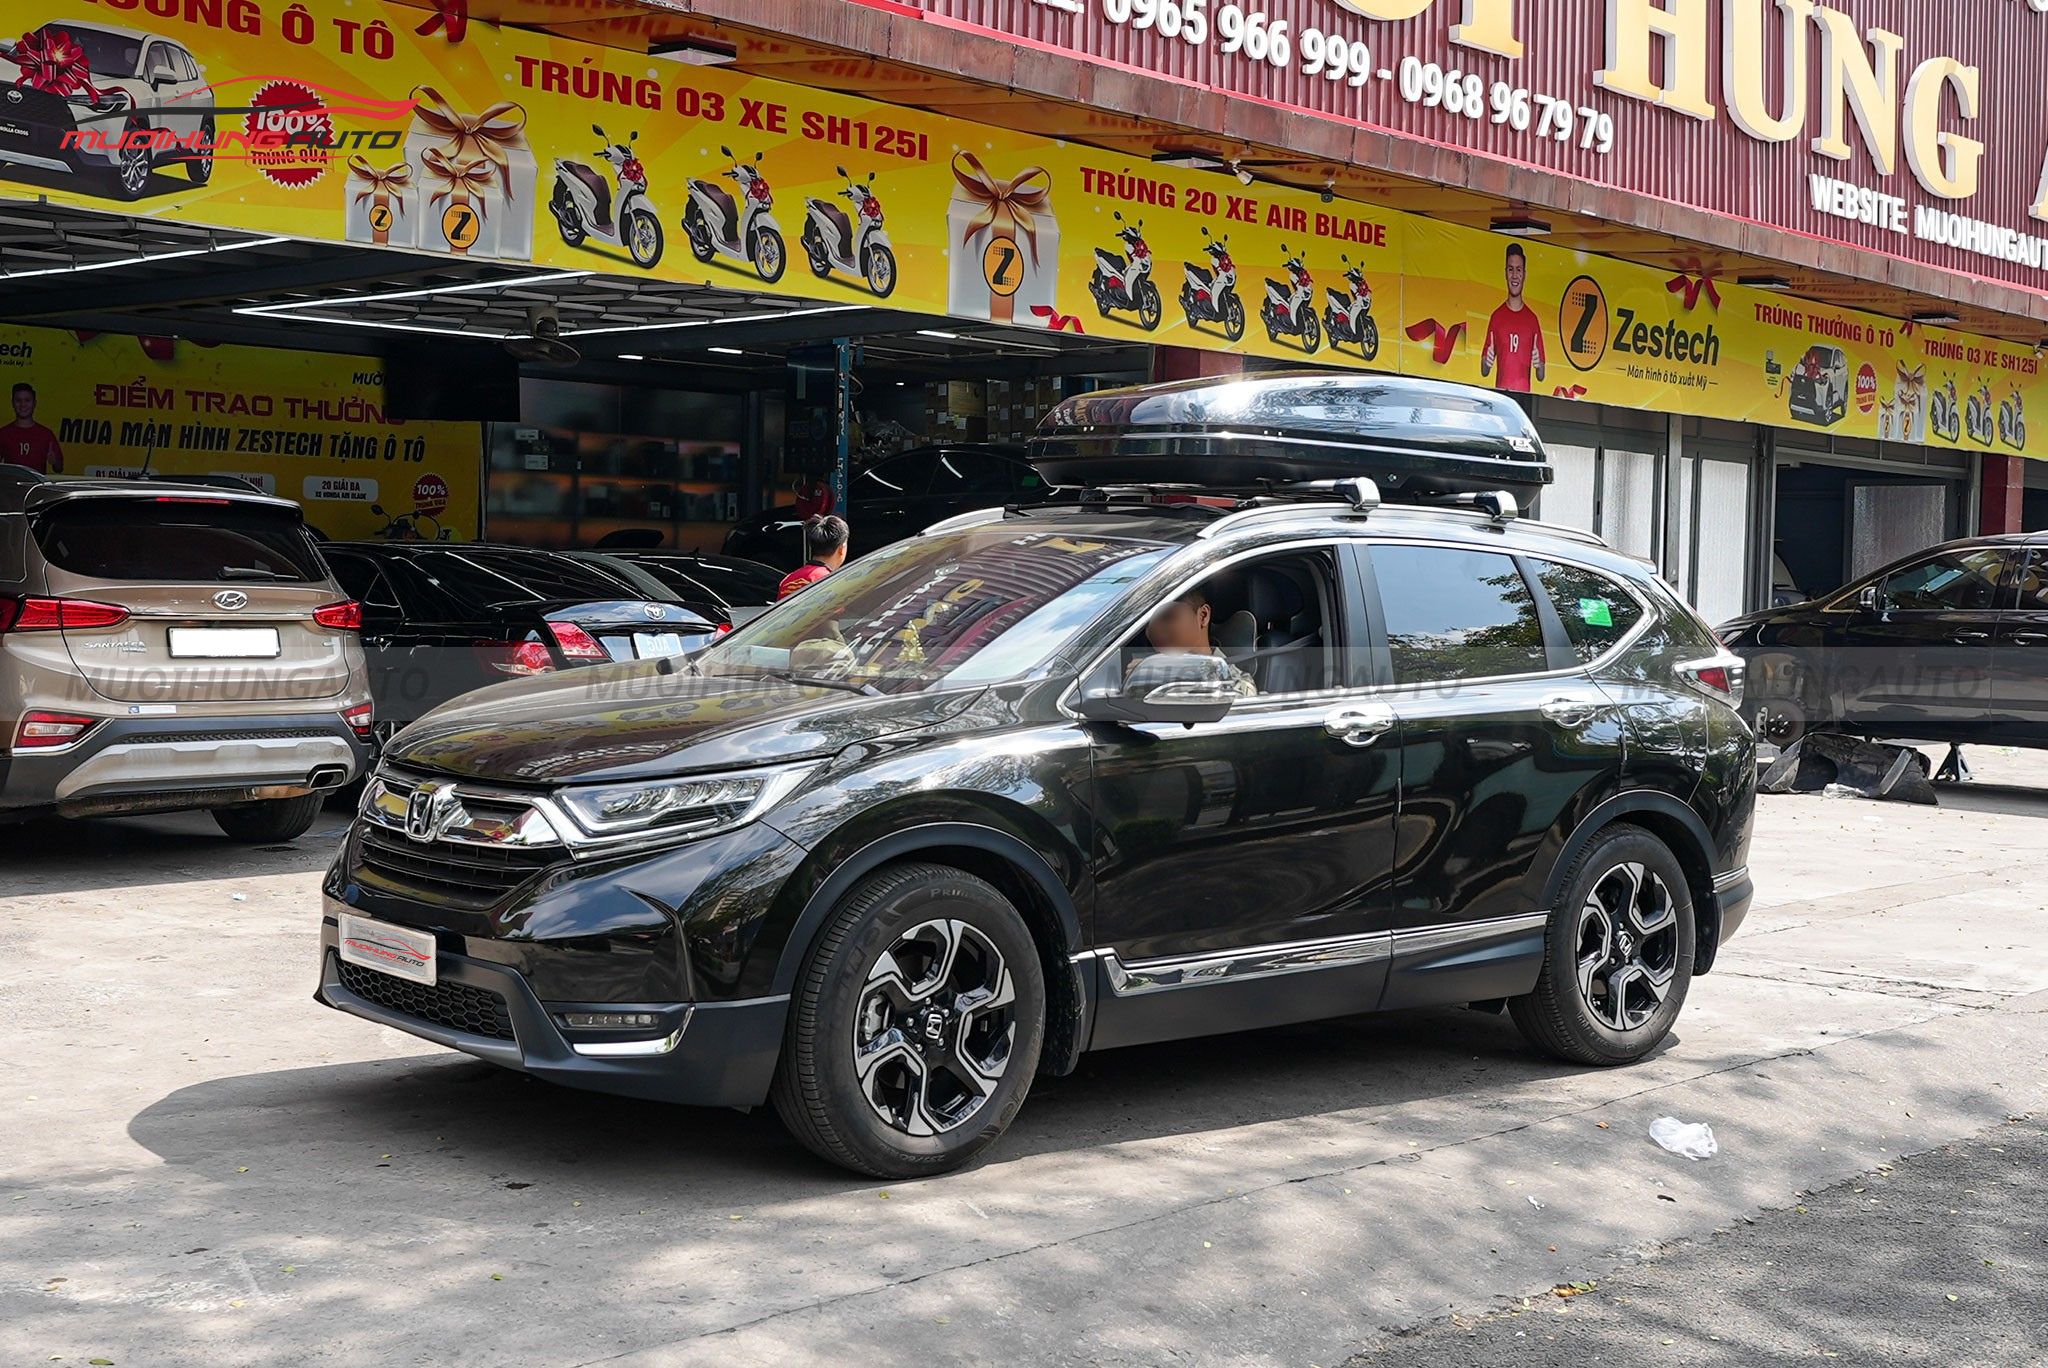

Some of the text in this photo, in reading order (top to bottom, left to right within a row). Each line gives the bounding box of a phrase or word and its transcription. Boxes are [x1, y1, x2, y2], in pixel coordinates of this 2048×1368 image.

[281, 3, 315, 46] Ô
[332, 18, 395, 61] TÔ
[1218, 4, 1291, 68] 966
[1299, 27, 1371, 88] 999
[1399, 55, 1484, 119] 0968
[1490, 81, 1532, 131] 96
[1533, 94, 1573, 142] 79
[1577, 107, 1614, 154] 79
[514, 55, 930, 161] TRÚNG 03 XE SH125I
[1080, 167, 1387, 247] TRÚNG 20 XE AIR BLADE
[1509, 333, 1519, 353] 19
[1613, 307, 1719, 366] Zestech
[1754, 303, 1894, 348] TRÚNG THƯỞNG Ô TÔ
[1924, 337, 1963, 361] TRÚNG
[1967, 347, 1980, 363] 03
[1984, 353, 1997, 368] XE
[1627, 364, 1708, 391] Màn hình ô tô xuất Mỹ
[1857, 375, 1876, 389] 100%
[94, 376, 406, 426] ĐIỂM TRAO THƯỞN
[19, 442, 31, 456] 19
[60, 417, 426, 464] MUA MÀN HÌNH ZESTECH TẶNG Ô TÔ
[322, 480, 331, 490] 20
[350, 481, 360, 492] BA
[417, 482, 447, 496] 100%
